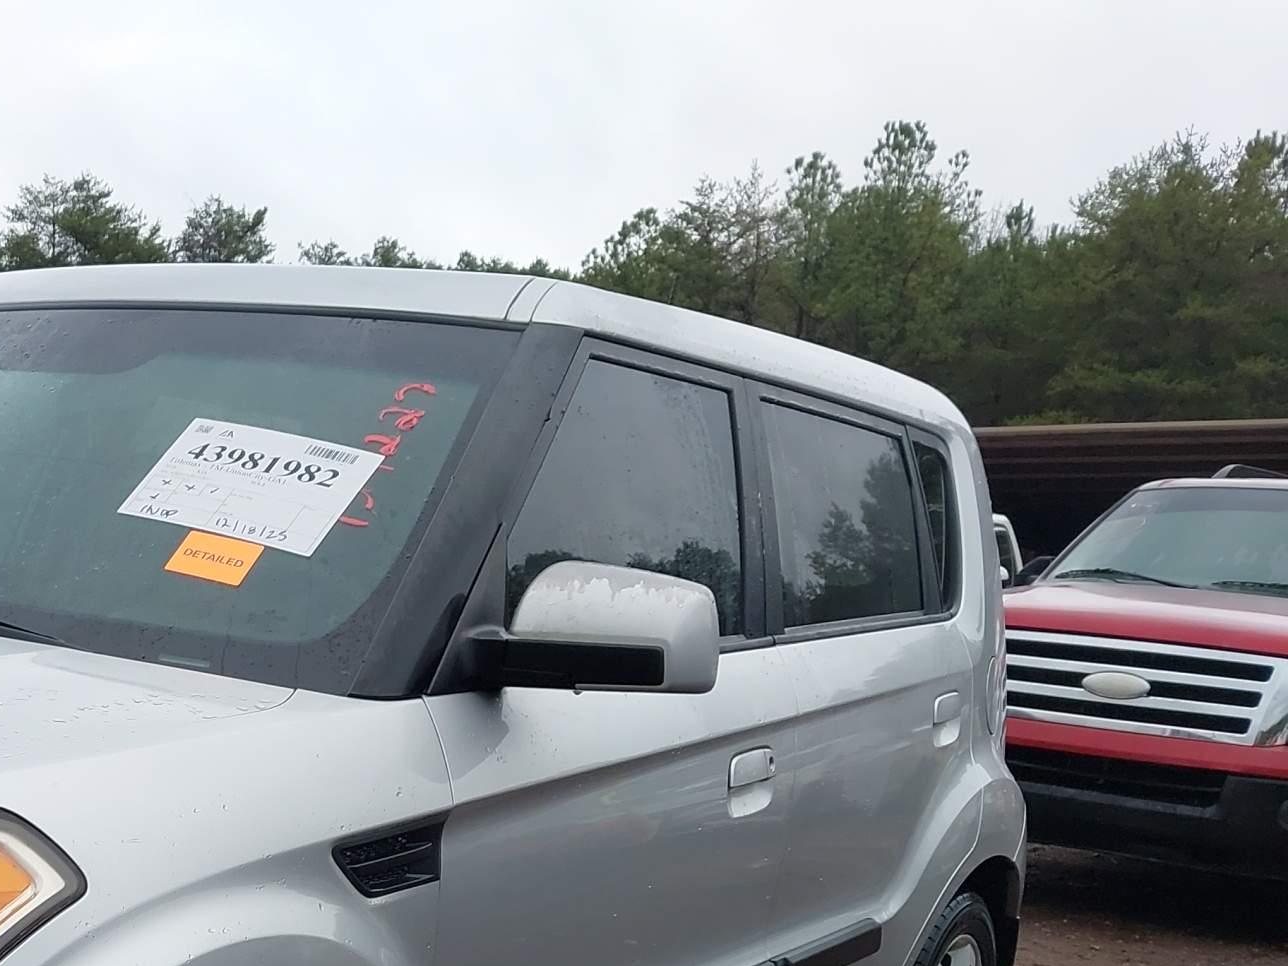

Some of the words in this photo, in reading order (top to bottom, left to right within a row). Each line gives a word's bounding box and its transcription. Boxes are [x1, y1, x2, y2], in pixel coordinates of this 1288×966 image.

[188, 443, 340, 488] 43981982
[215, 517, 288, 542] 12/18/25
[183, 547, 245, 568] DETAILED
